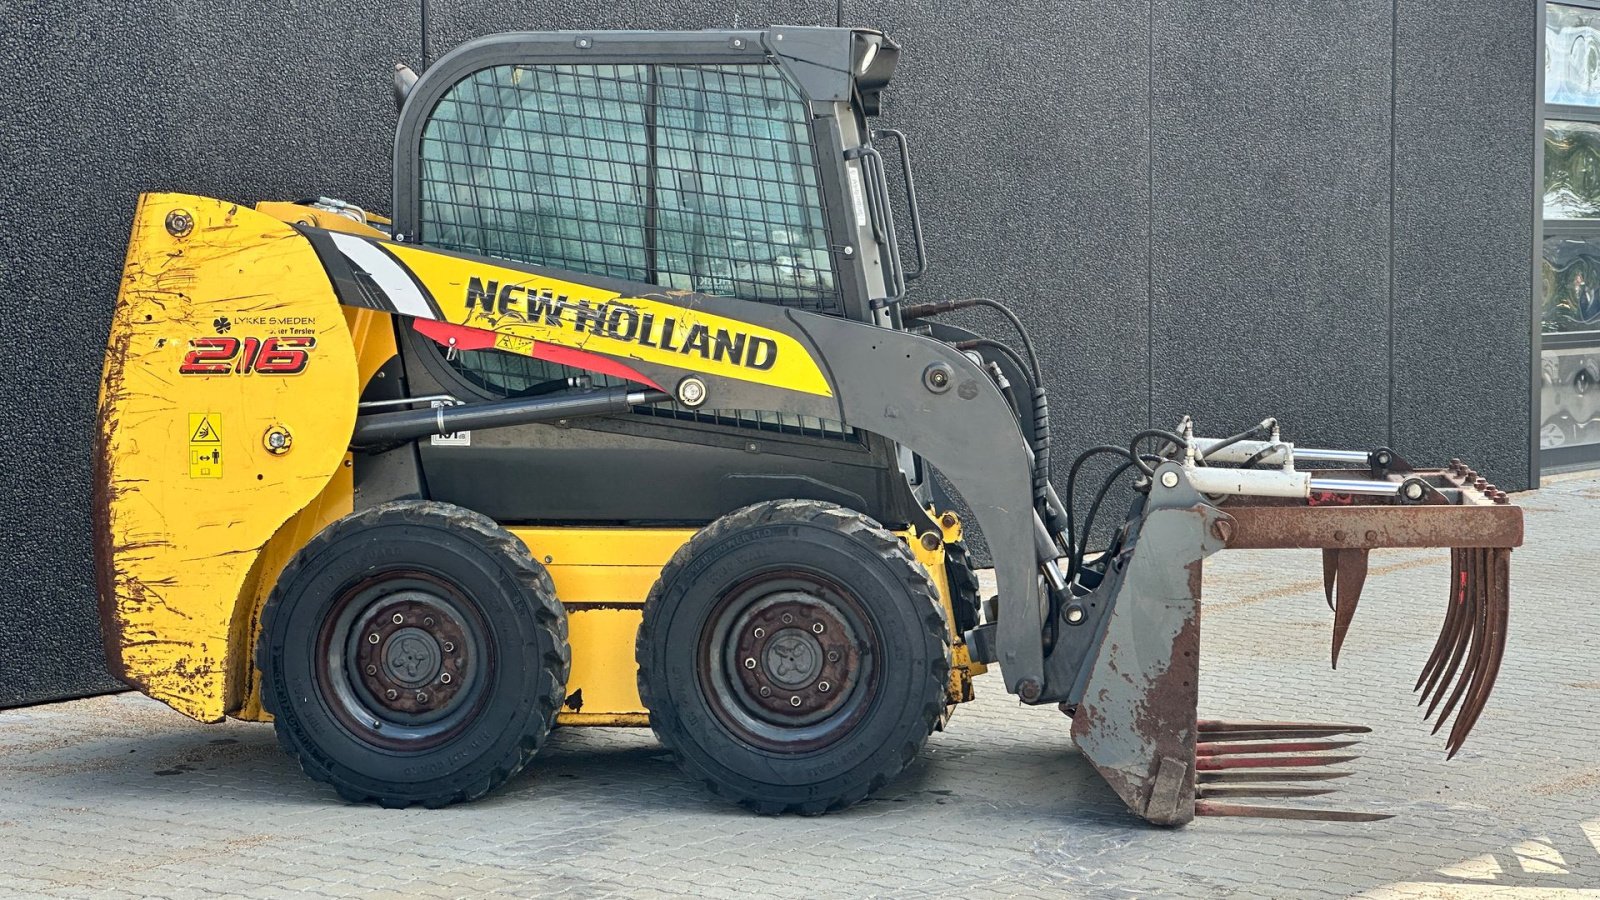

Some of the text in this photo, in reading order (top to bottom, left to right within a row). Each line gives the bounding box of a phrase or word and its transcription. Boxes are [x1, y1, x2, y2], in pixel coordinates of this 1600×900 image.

[234, 317, 267, 325] LYKKE
[464, 276, 778, 372] NEW HOLLAND
[179, 336, 317, 374] 216
